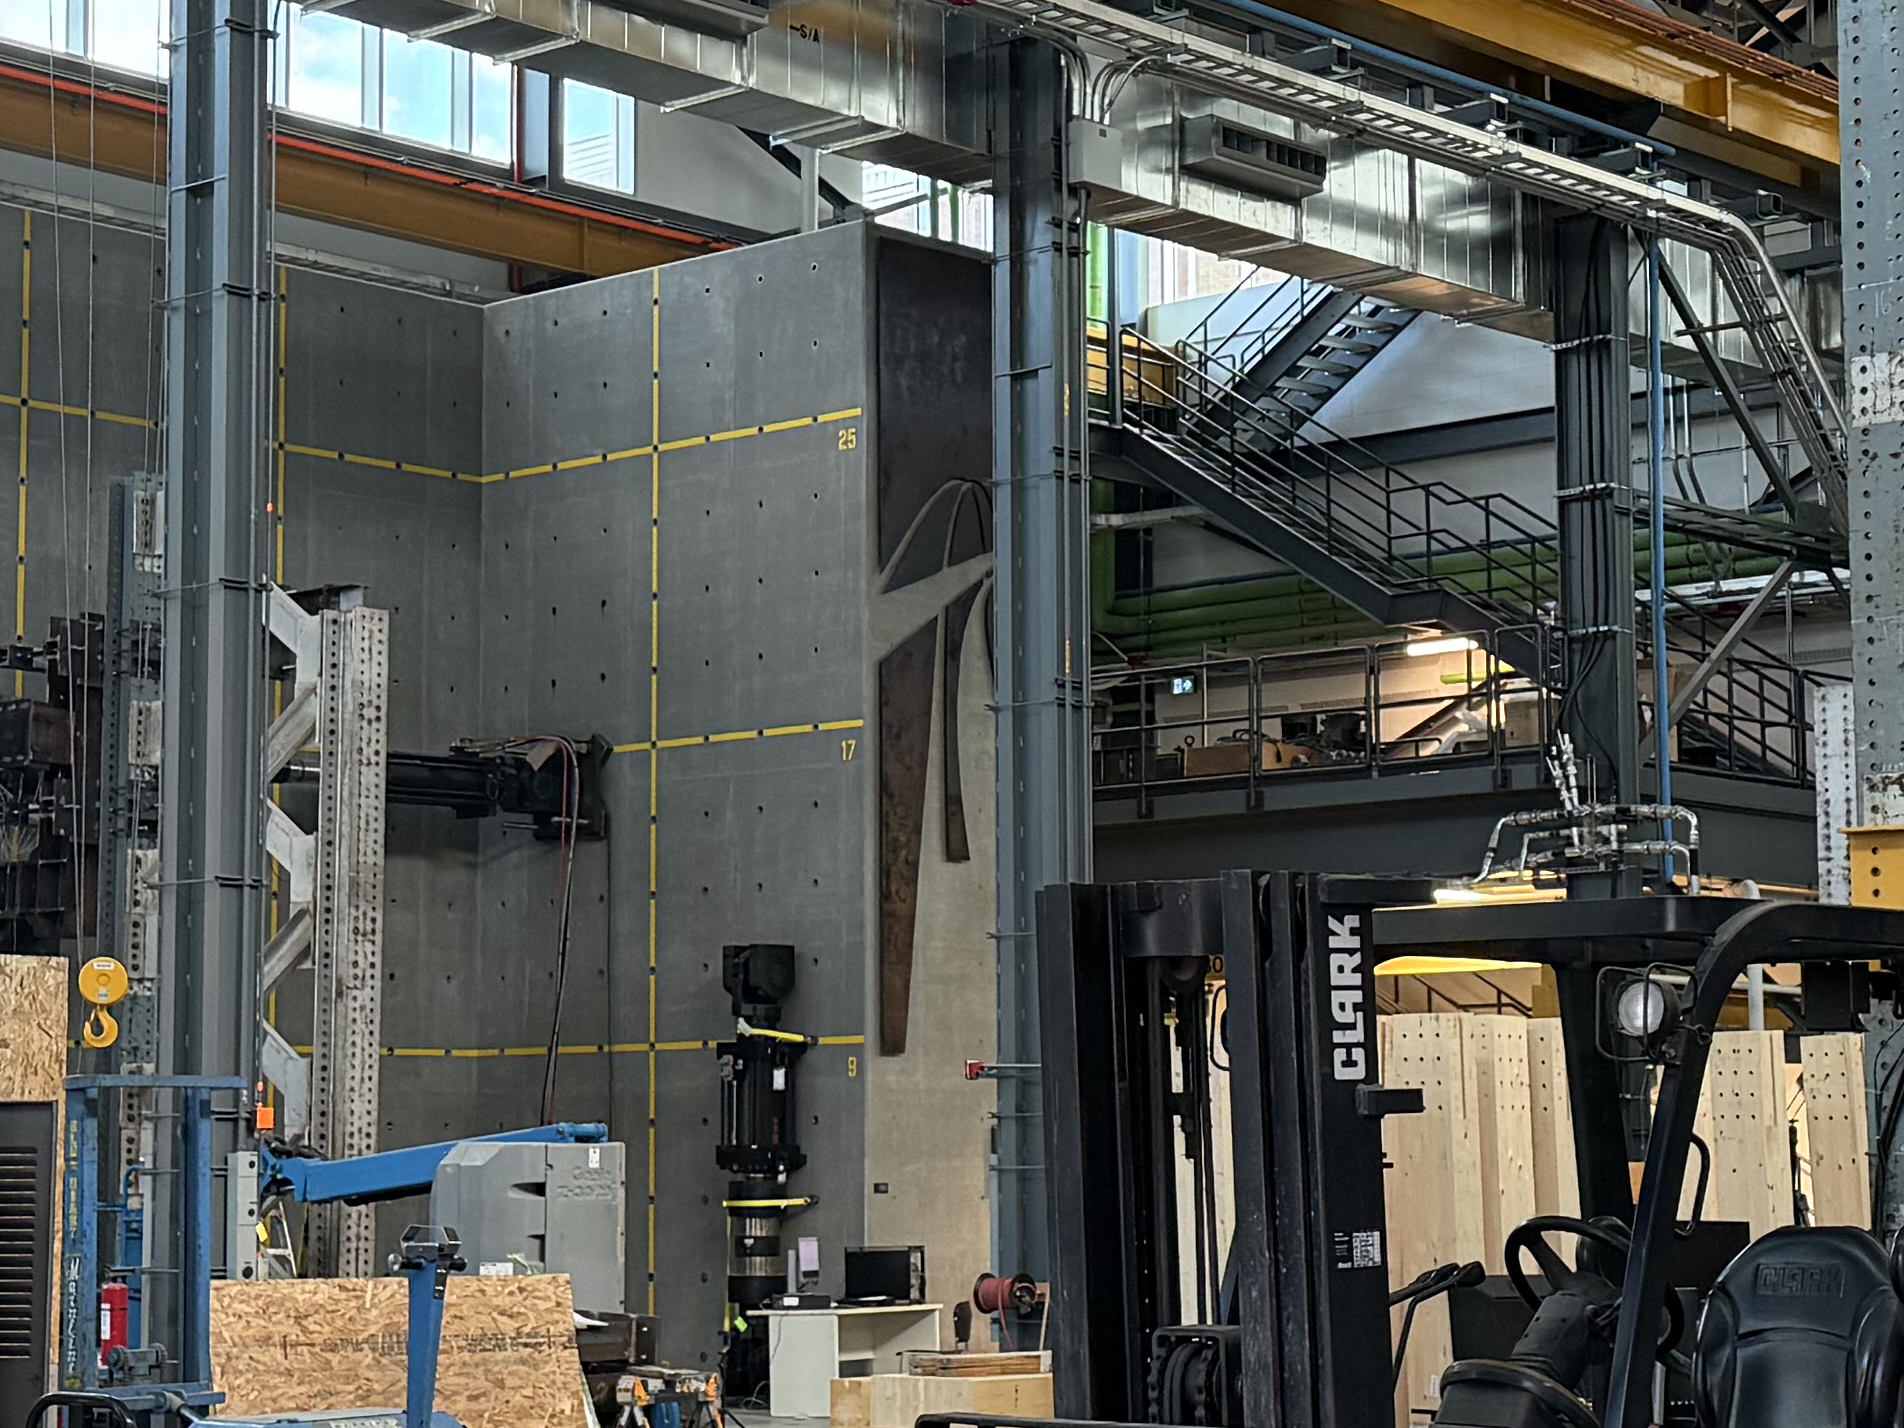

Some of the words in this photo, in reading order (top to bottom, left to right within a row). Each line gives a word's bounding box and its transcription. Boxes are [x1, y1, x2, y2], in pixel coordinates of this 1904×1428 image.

[838, 427, 857, 450] 25
[841, 739, 856, 761] 17
[1327, 914, 1366, 1080] CLARK
